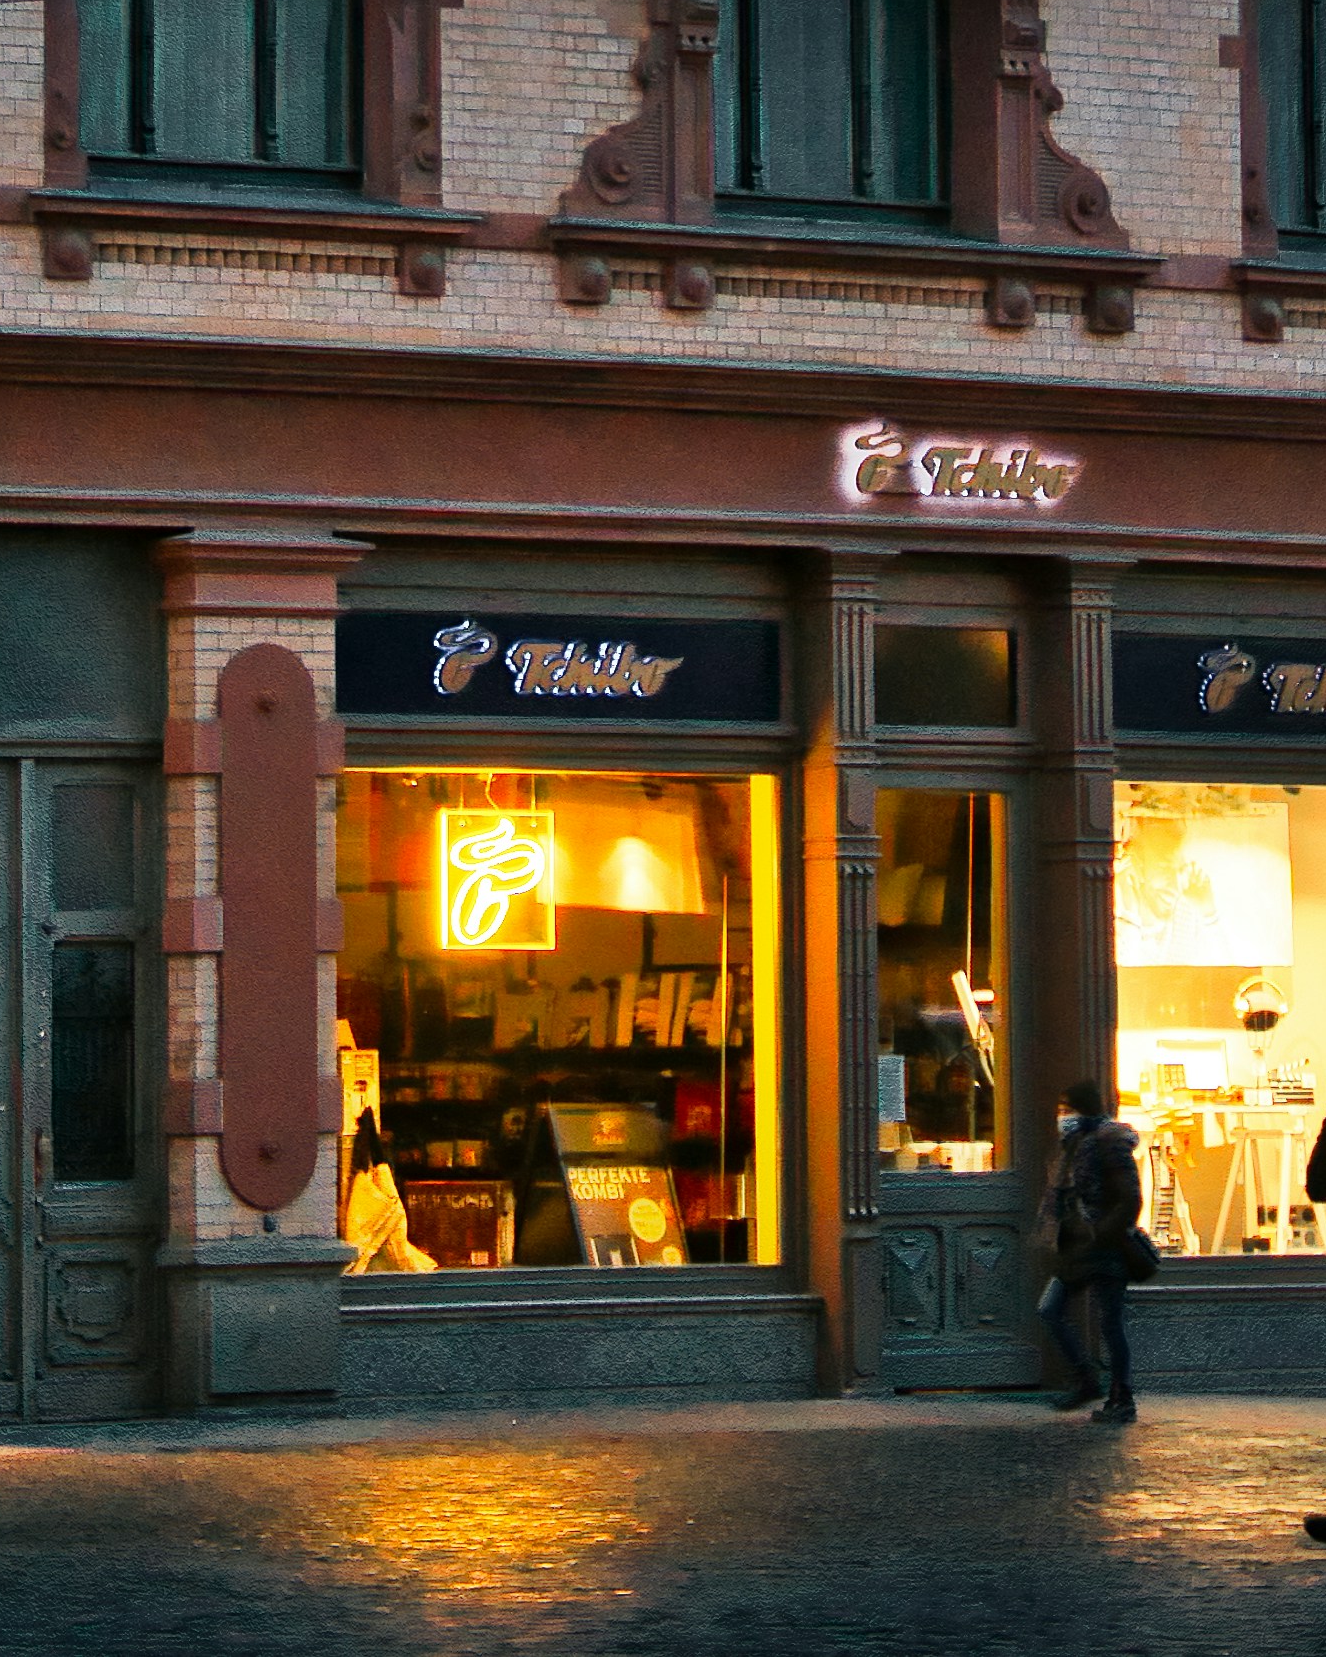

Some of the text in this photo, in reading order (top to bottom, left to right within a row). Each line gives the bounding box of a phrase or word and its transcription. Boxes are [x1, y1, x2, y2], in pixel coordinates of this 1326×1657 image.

[921, 445, 1076, 500] Tchibo
[568, 1166, 651, 1184] PERFEKTE
[571, 1182, 626, 1200] KOMBI
